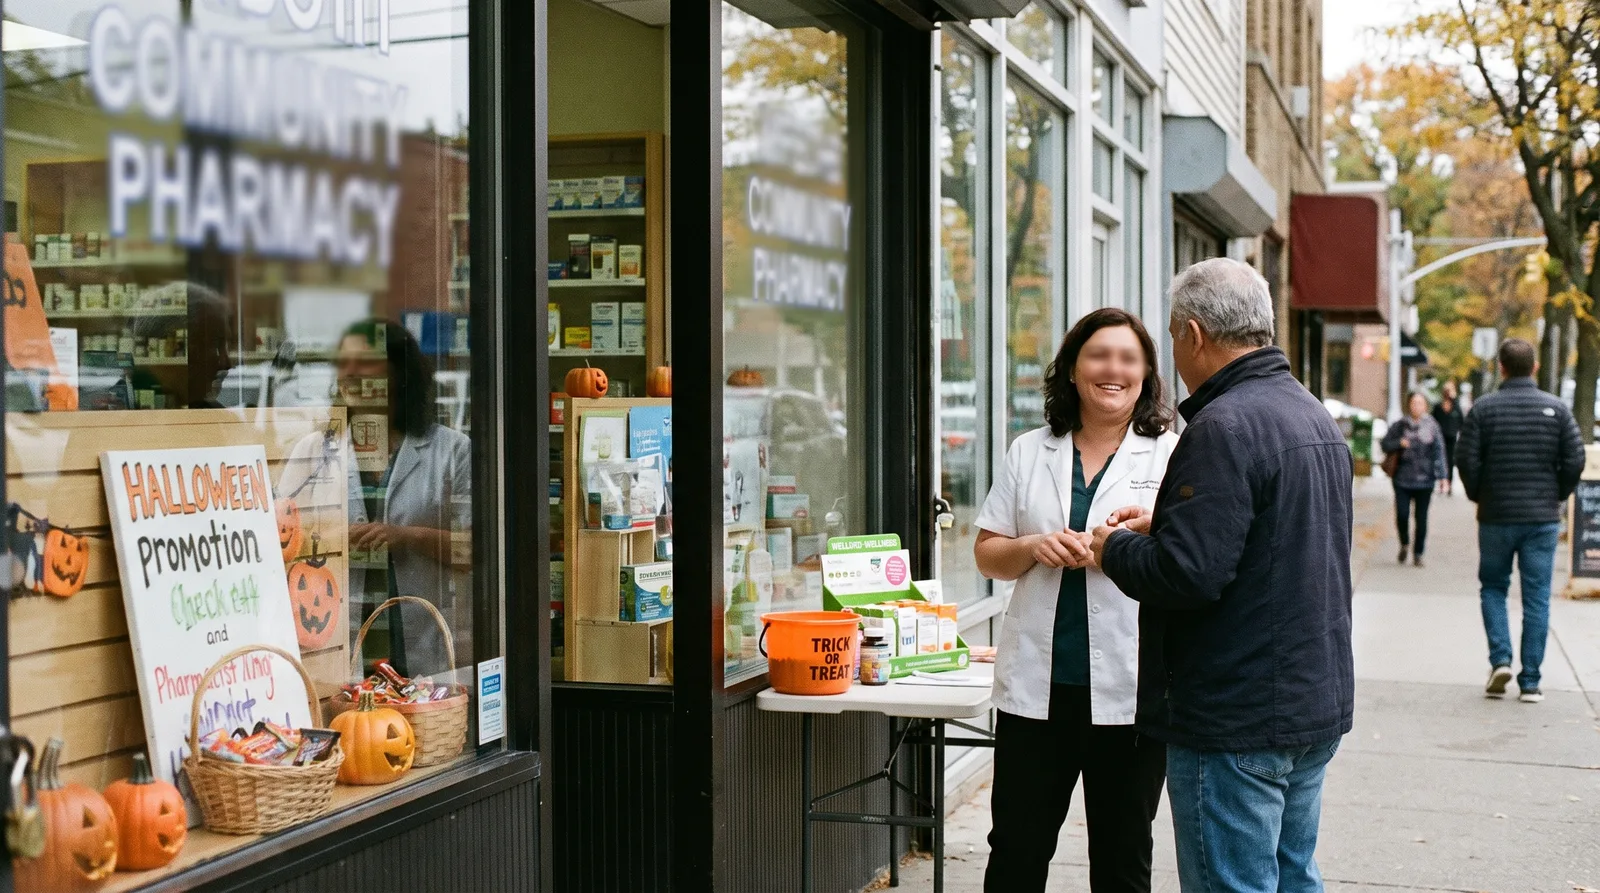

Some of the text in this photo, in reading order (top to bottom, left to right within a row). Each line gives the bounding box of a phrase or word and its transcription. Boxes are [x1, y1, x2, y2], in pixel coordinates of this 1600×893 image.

[88, 5, 408, 168] COMMUNITY
[108, 130, 400, 271] PHARMACY
[121, 459, 270, 523] HALLOWEEN
[206, 623, 229, 645] and
[811, 636, 851, 653] TRICK
[824, 653, 840, 665] OR
[809, 664, 851, 681] TREAT
